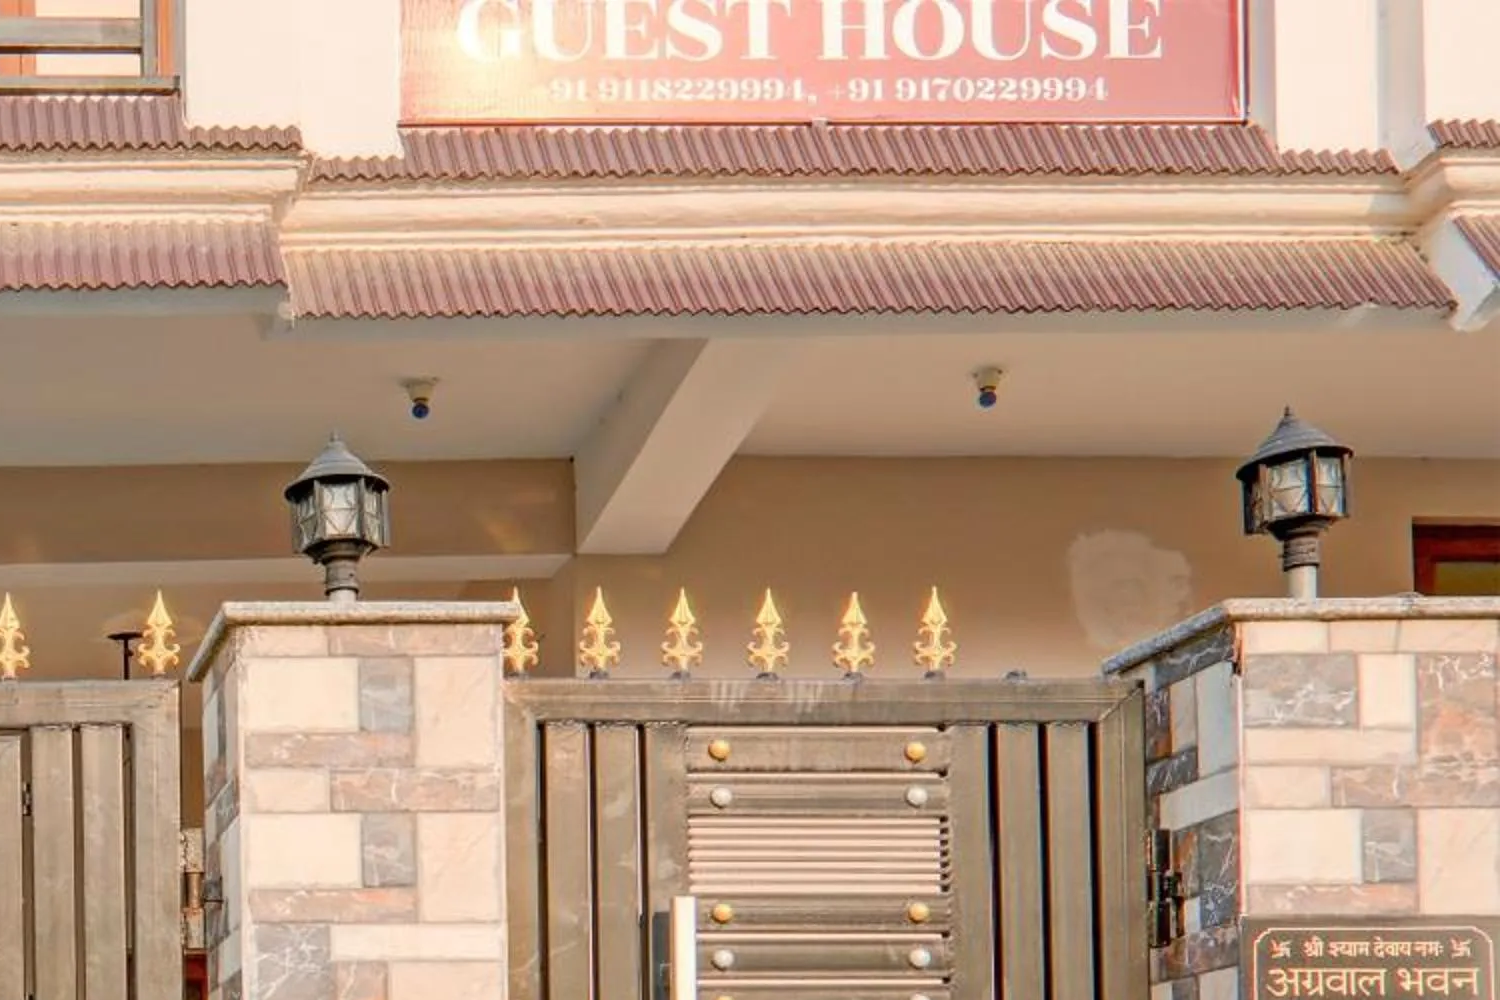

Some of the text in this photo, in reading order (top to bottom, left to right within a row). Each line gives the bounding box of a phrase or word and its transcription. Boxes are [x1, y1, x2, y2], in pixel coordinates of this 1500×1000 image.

[456, 0, 1163, 61] GUEST HOUSE
[831, 77, 885, 102] +91
[895, 77, 1108, 102] 9170229994
[1303, 935, 1325, 957] श्री
[1327, 940, 1370, 957] श्याम
[1266, 967, 1479, 996] अग्रवाल भवन
